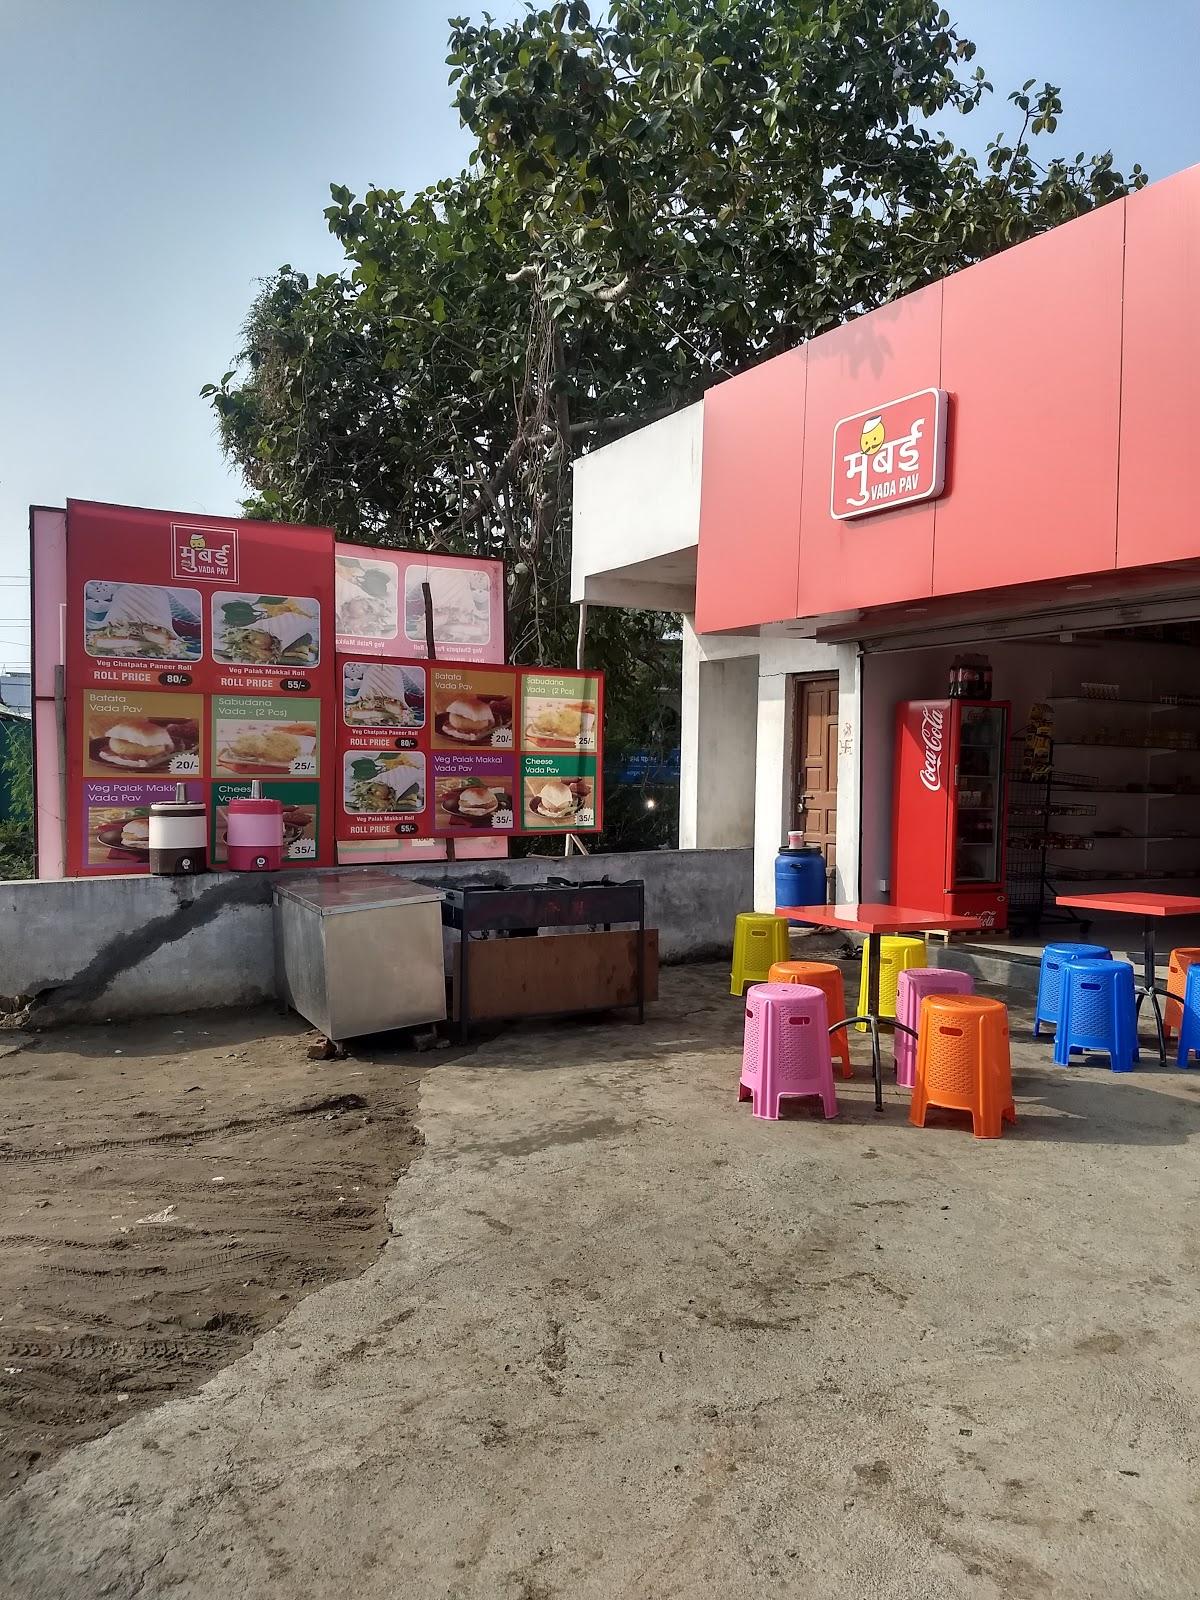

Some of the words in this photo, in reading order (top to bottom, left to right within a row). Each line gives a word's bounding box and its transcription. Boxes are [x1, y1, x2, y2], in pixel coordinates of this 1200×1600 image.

[871, 480, 896, 500] VADA
[899, 473, 919, 494] PAV
[198, 566, 215, 574] VADA
[216, 567, 229, 576] PAV
[96, 660, 111, 668] Veg
[113, 660, 147, 669] Chatpata
[150, 662, 176, 670] Paneer
[229, 667, 242, 675] Veg
[244, 667, 263, 675] Palak
[93, 671, 119, 681] ROLL
[122, 672, 151, 682] PRICE
[166, 675, 187, 683] 80/-
[435, 672, 462, 680] Batata
[221, 678, 244, 687] ROLL
[246, 679, 273, 688] PRICE
[287, 680, 305, 689] 55/-
[458, 682, 473, 690] Pav
[526, 677, 564, 686] Sabudana
[552, 687, 559, 695] (2
[89, 693, 126, 703] Batata
[218, 698, 272, 707] Sabudana
[89, 704, 119, 713] Vada
[122, 705, 143, 713] Pav
[218, 707, 245, 716] Vada
[255, 708, 265, 717] (2
[267, 708, 287, 717] Pcs)
[352, 728, 362, 736] Veg
[350, 738, 368, 746] ROLL
[400, 739, 415, 747] 80/-
[496, 735, 512, 743] 20/-
[578, 737, 594, 745] 25/-
[434, 755, 450, 764] Veg
[452, 755, 474, 763] Palak
[476, 756, 503, 764] Makkai
[176, 761, 199, 770] 20/-
[294, 761, 315, 770] 25/-
[434, 764, 457, 772] Vada
[458, 764, 473, 772] Pav
[525, 766, 545, 774] Vada
[546, 766, 560, 774] Pav
[88, 784, 110, 793] Veg
[113, 784, 143, 792] Palak
[218, 785, 252, 793] Chees
[88, 794, 119, 802] Vada
[121, 794, 141, 802] Pav
[496, 816, 512, 824] 35/-
[579, 814, 594, 822] 35/-
[350, 826, 368, 834] ROLL
[369, 825, 390, 833] PRICE
[294, 845, 315, 854] 35/-
